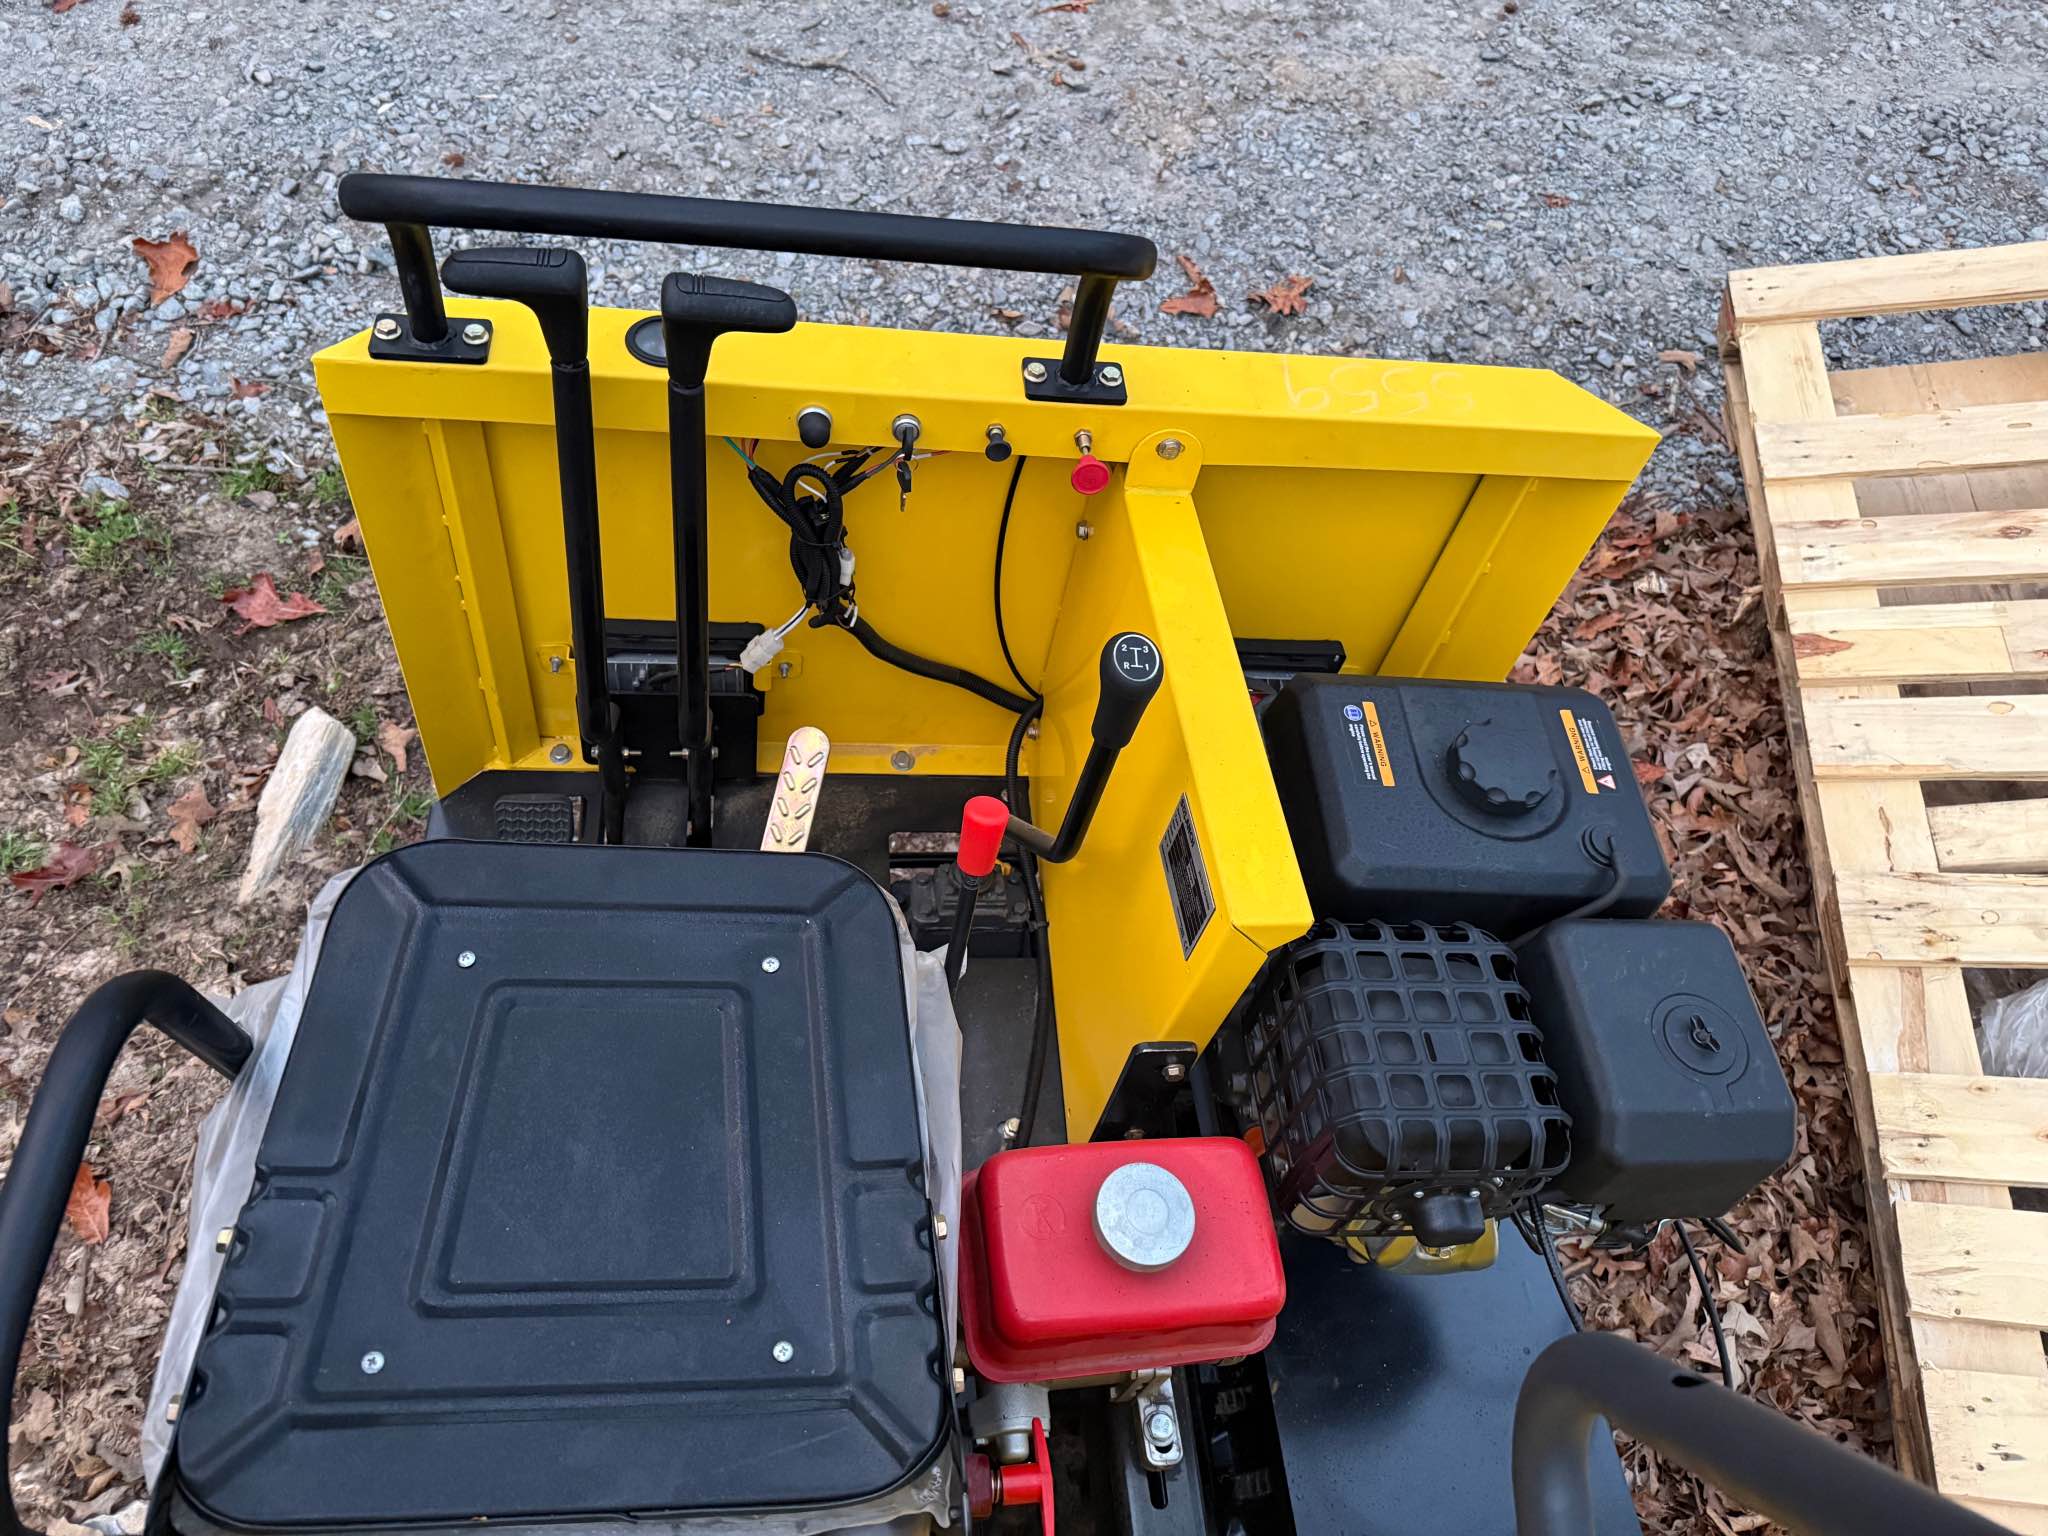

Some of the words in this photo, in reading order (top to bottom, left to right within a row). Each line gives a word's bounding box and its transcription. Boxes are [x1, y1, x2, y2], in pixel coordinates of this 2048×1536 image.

[1123, 661, 1130, 669] R
[1145, 663, 1149, 671] 1
[1372, 732, 1387, 767] WARNING
[1569, 727, 1586, 762] WARNING
